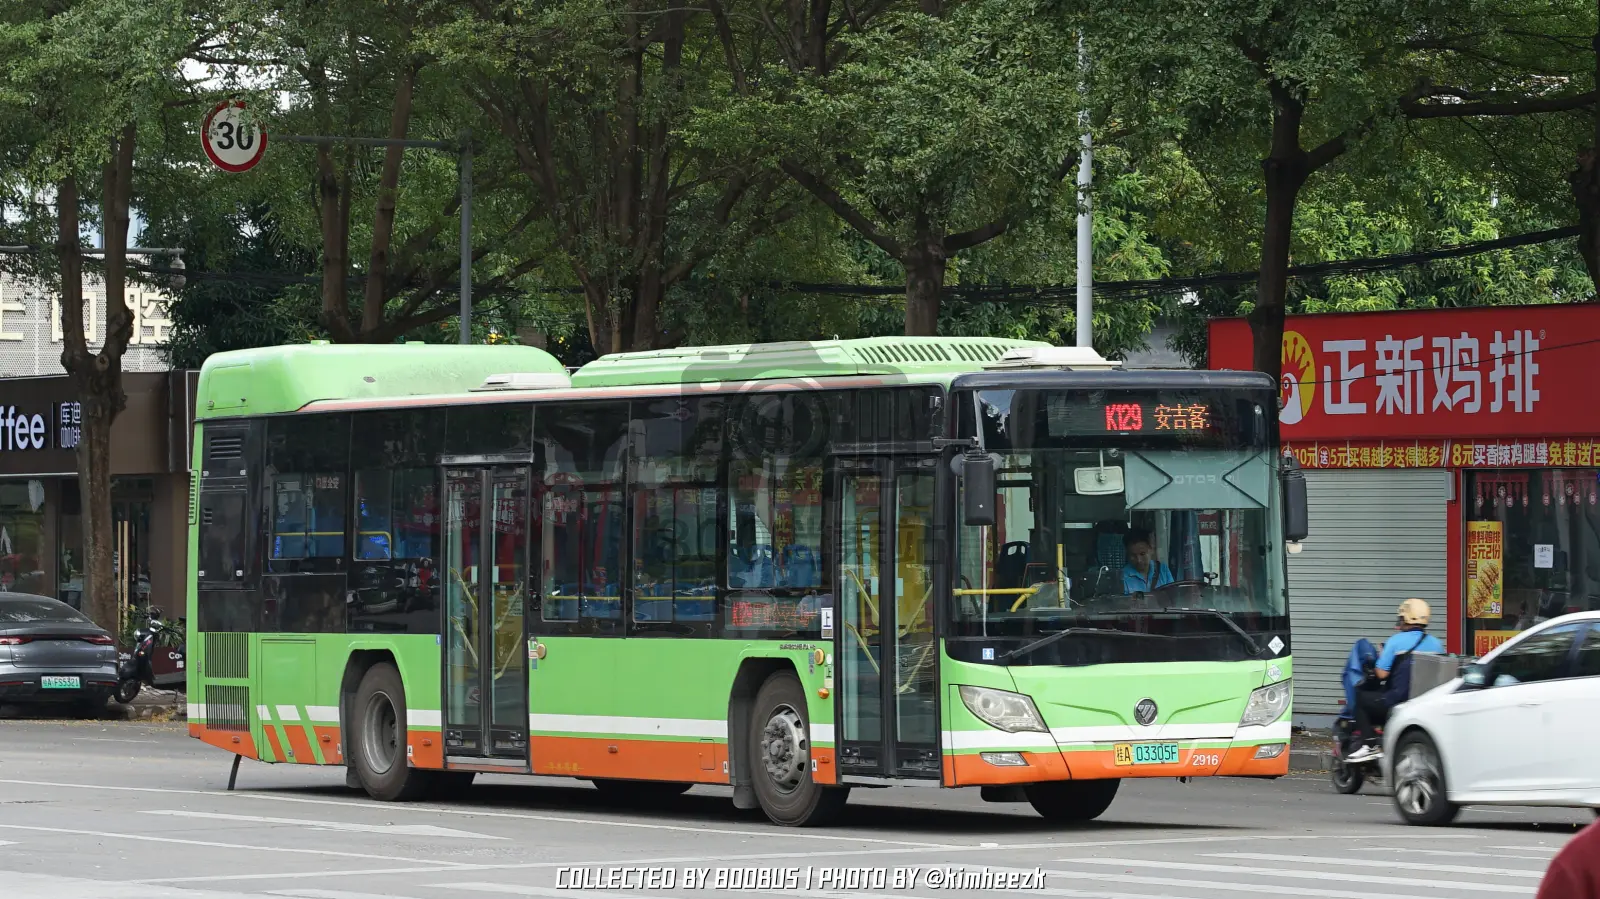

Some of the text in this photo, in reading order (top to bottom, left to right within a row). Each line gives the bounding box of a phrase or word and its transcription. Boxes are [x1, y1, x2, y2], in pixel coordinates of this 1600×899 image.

[216, 121, 254, 150] 30
[1322, 329, 1540, 415] 正新鸡排
[60, 401, 81, 424] 库迪
[1105, 403, 1210, 430] K129 安吉客
[1116, 745, 1177, 762] 桂A 03305F
[1192, 754, 1219, 767] 2916
